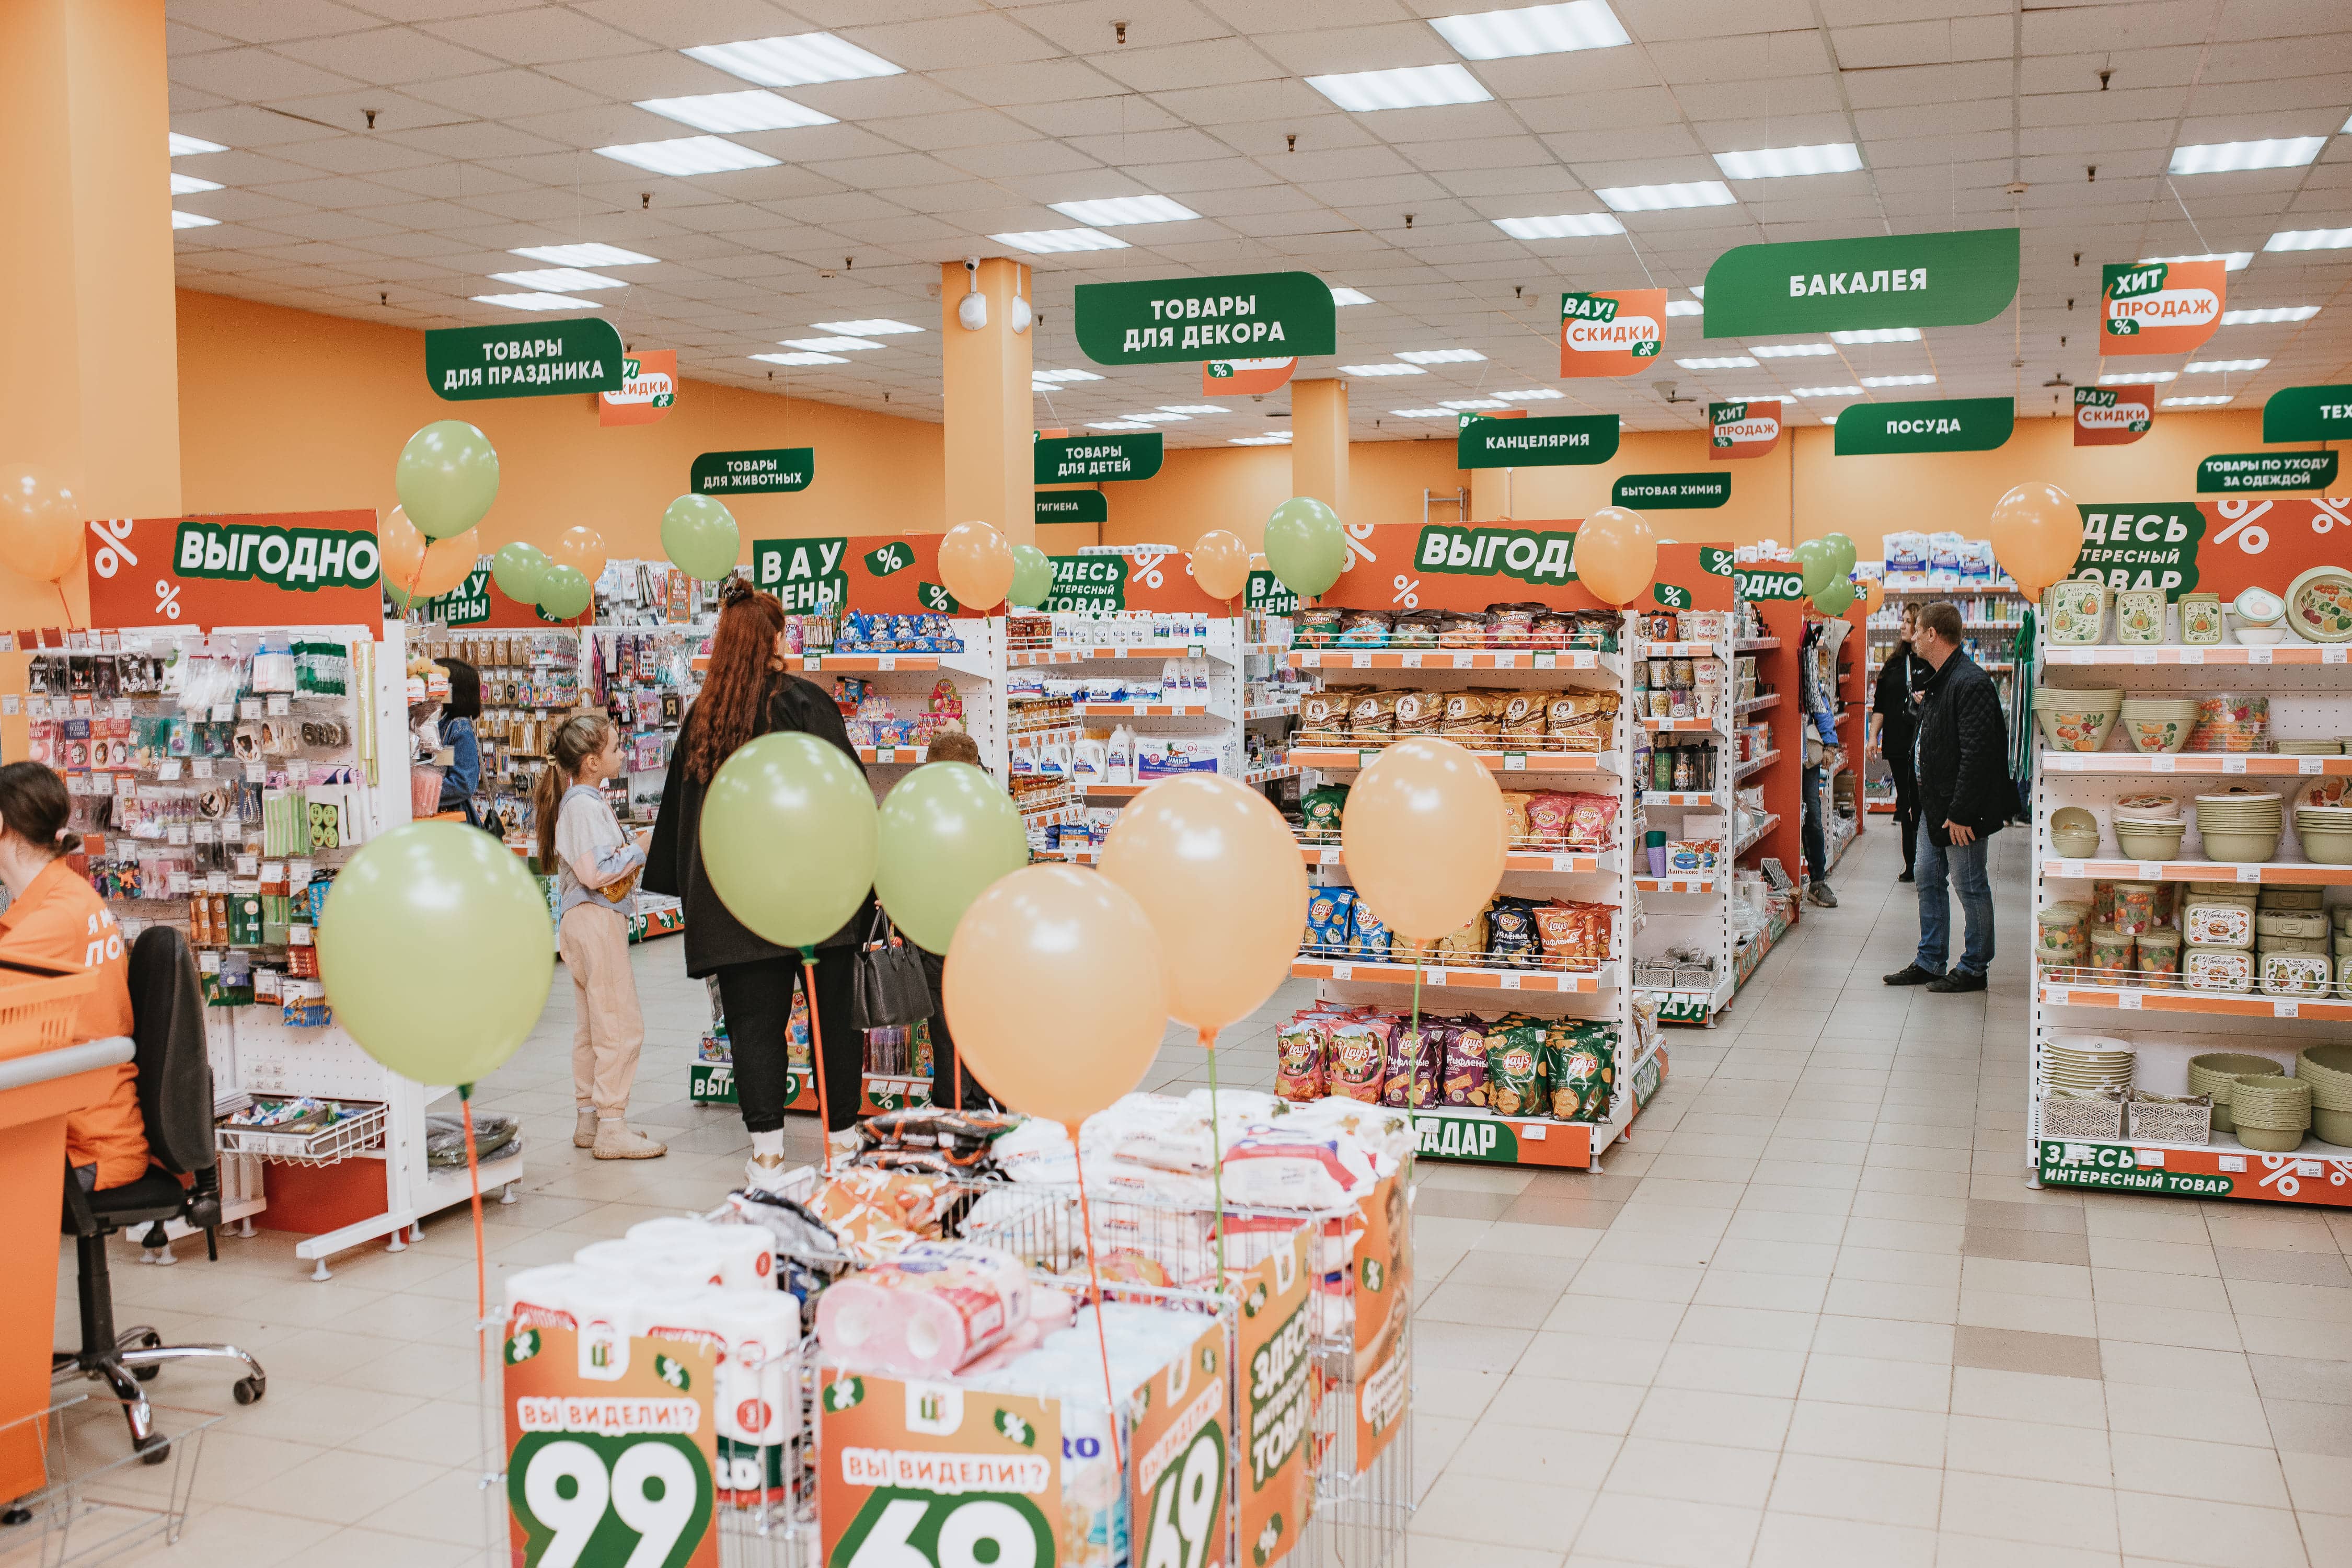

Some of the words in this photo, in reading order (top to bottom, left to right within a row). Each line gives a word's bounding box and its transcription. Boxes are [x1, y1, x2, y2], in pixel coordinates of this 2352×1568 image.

[1790, 269, 1927, 297] БАКАЛЕЯ
[2116, 268, 2162, 295] ХИТ
[1151, 295, 1255, 320] ТОВАРЫ
[1564, 298, 1614, 320] ВАУ!
[2117, 297, 2212, 318] ПРОДАЖ
[1124, 329, 1174, 352] ДЛЯ
[1182, 321, 1285, 349] ДЕКОРА
[1573, 326, 1654, 343] СКИДКИ
[483, 338, 563, 361] ТОВАРЫ
[444, 368, 482, 390] ДЛЯ
[488, 360, 604, 385] ПРАЗДНИКА
[608, 381, 668, 396] КИДКИ
[2076, 388, 2114, 407] ВАУ!
[1717, 406, 1744, 420] ХИТ
[2082, 407, 2146, 422] СКИДКИ
[1718, 423, 1775, 437] ПРОДАЖ
[1887, 418, 1961, 434] ПОСУДА
[1486, 434, 1589, 449] КАНЦЕЛЯРИЯ
[1066, 445, 1122, 459] ТОВАРЫ
[727, 459, 777, 472] ТОВАРЫ
[1058, 463, 1085, 476] ДЛЯ
[1089, 458, 1131, 475] ДЕТЕЙ
[2206, 460, 2258, 472] ТОВАРЫ
[2262, 459, 2281, 470] ПО
[2284, 458, 2329, 470] УХОДУ
[703, 476, 728, 489] ДЛЯ
[731, 472, 802, 487] ЖИВОТНЫХ
[2224, 476, 2239, 487] ЗА
[2243, 472, 2311, 487] ОДЕЖДОЙ
[1621, 486, 1677, 497] БЫТОВАЯ
[1680, 484, 1722, 495] ХИМИЯ
[1036, 502, 1078, 512] ГИГИЕНА
[2083, 513, 2188, 545] ДЕСЬ
[180, 531, 379, 582] ВЫГОДНО
[762, 541, 841, 584] ВАУ
[1422, 533, 1575, 578] ВЫГОД
[2082, 548, 2180, 564] ТЕРЕСНЫЙ
[763, 579, 841, 610] ЕНЫ
[1052, 583, 1114, 595] НТЕРЕСНЫЙ
[1252, 577, 1286, 597] ВА
[434, 597, 487, 621] ЦЕНЫ
[1044, 597, 1116, 614] ТОВАР
[1312, 903, 1332, 916] Lay's
[2204, 910, 2235, 919] Hamburger
[88, 914, 98, 936] Я
[1500, 916, 1519, 927] Lay's
[1550, 921, 1567, 932] Lay's
[2204, 956, 2235, 966] Hamburger
[1288, 1043, 1309, 1058] Lay's
[1462, 1036, 1483, 1051] Lay's
[1344, 1046, 1368, 1061] Lay's
[1447, 1054, 1488, 1068] Рифлены
[1505, 1054, 1529, 1069] Lay's
[2045, 1168, 2162, 1189] ИНТЕРЕСНЫЙ
[2170, 1177, 2230, 1193] ТОВАР
[1254, 1309, 1308, 1399] ЗДЕС
[524, 1405, 559, 1423] ВЫ
[571, 1406, 695, 1427] ВИДЕЛИ!?
[849, 1456, 885, 1478] ВЫ
[901, 1458, 1043, 1486] ВИДЕЛИ!?
[524, 1441, 697, 1568] 99
